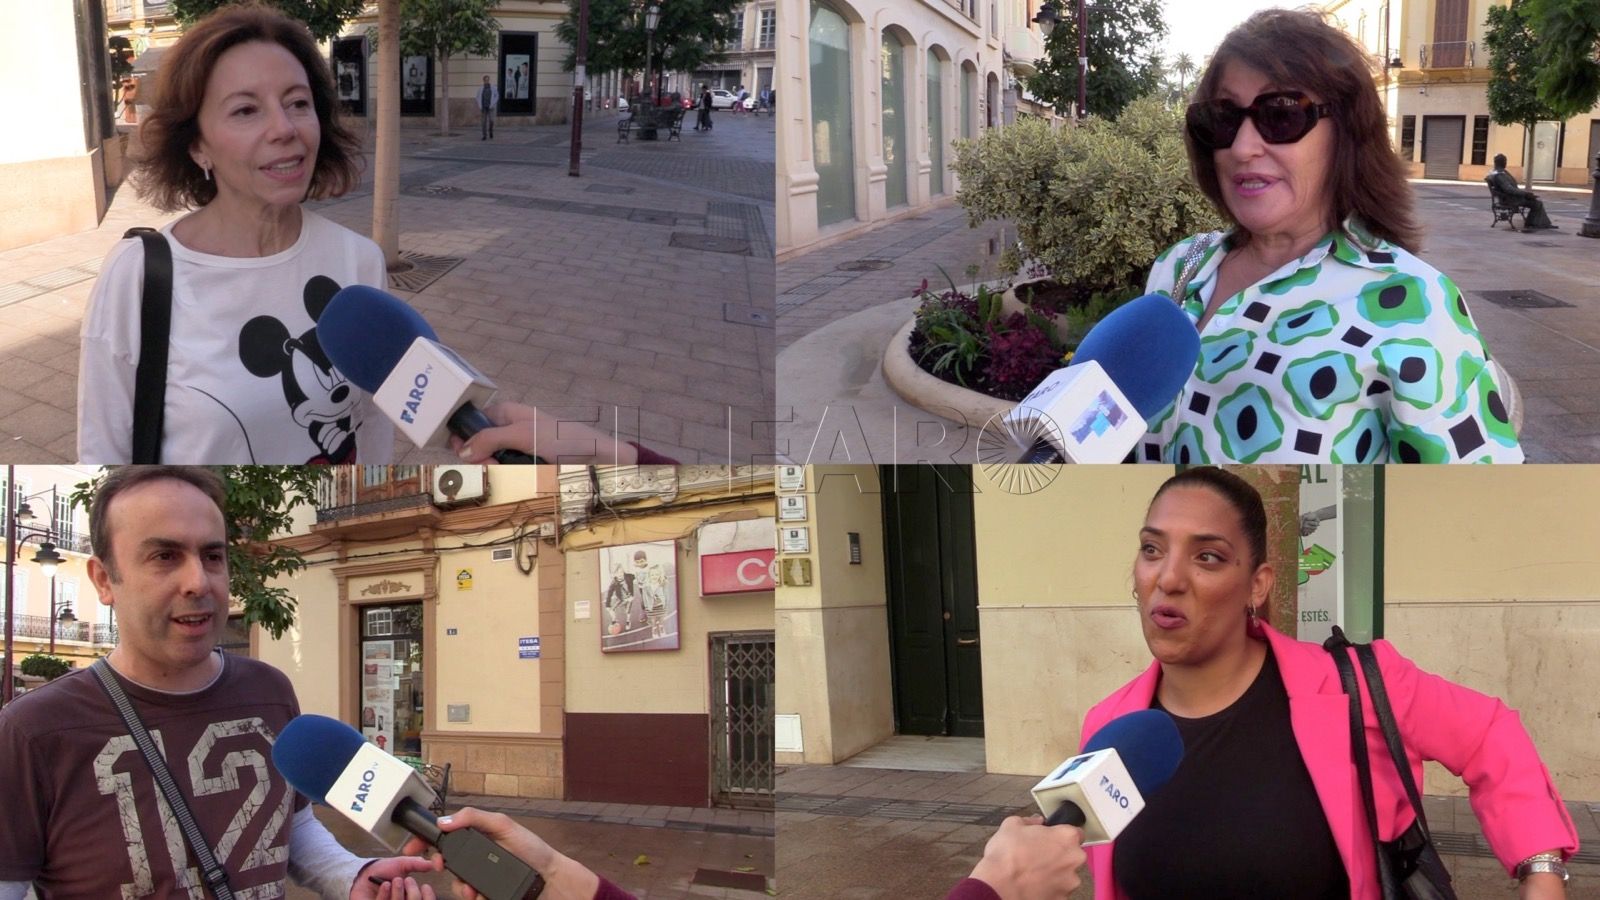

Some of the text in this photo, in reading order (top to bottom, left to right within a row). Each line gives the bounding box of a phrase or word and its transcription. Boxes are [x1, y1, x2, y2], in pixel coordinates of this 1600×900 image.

[400, 373, 429, 425] FARO
[351, 769, 376, 813] FARO
[1099, 775, 1129, 809] FARO
